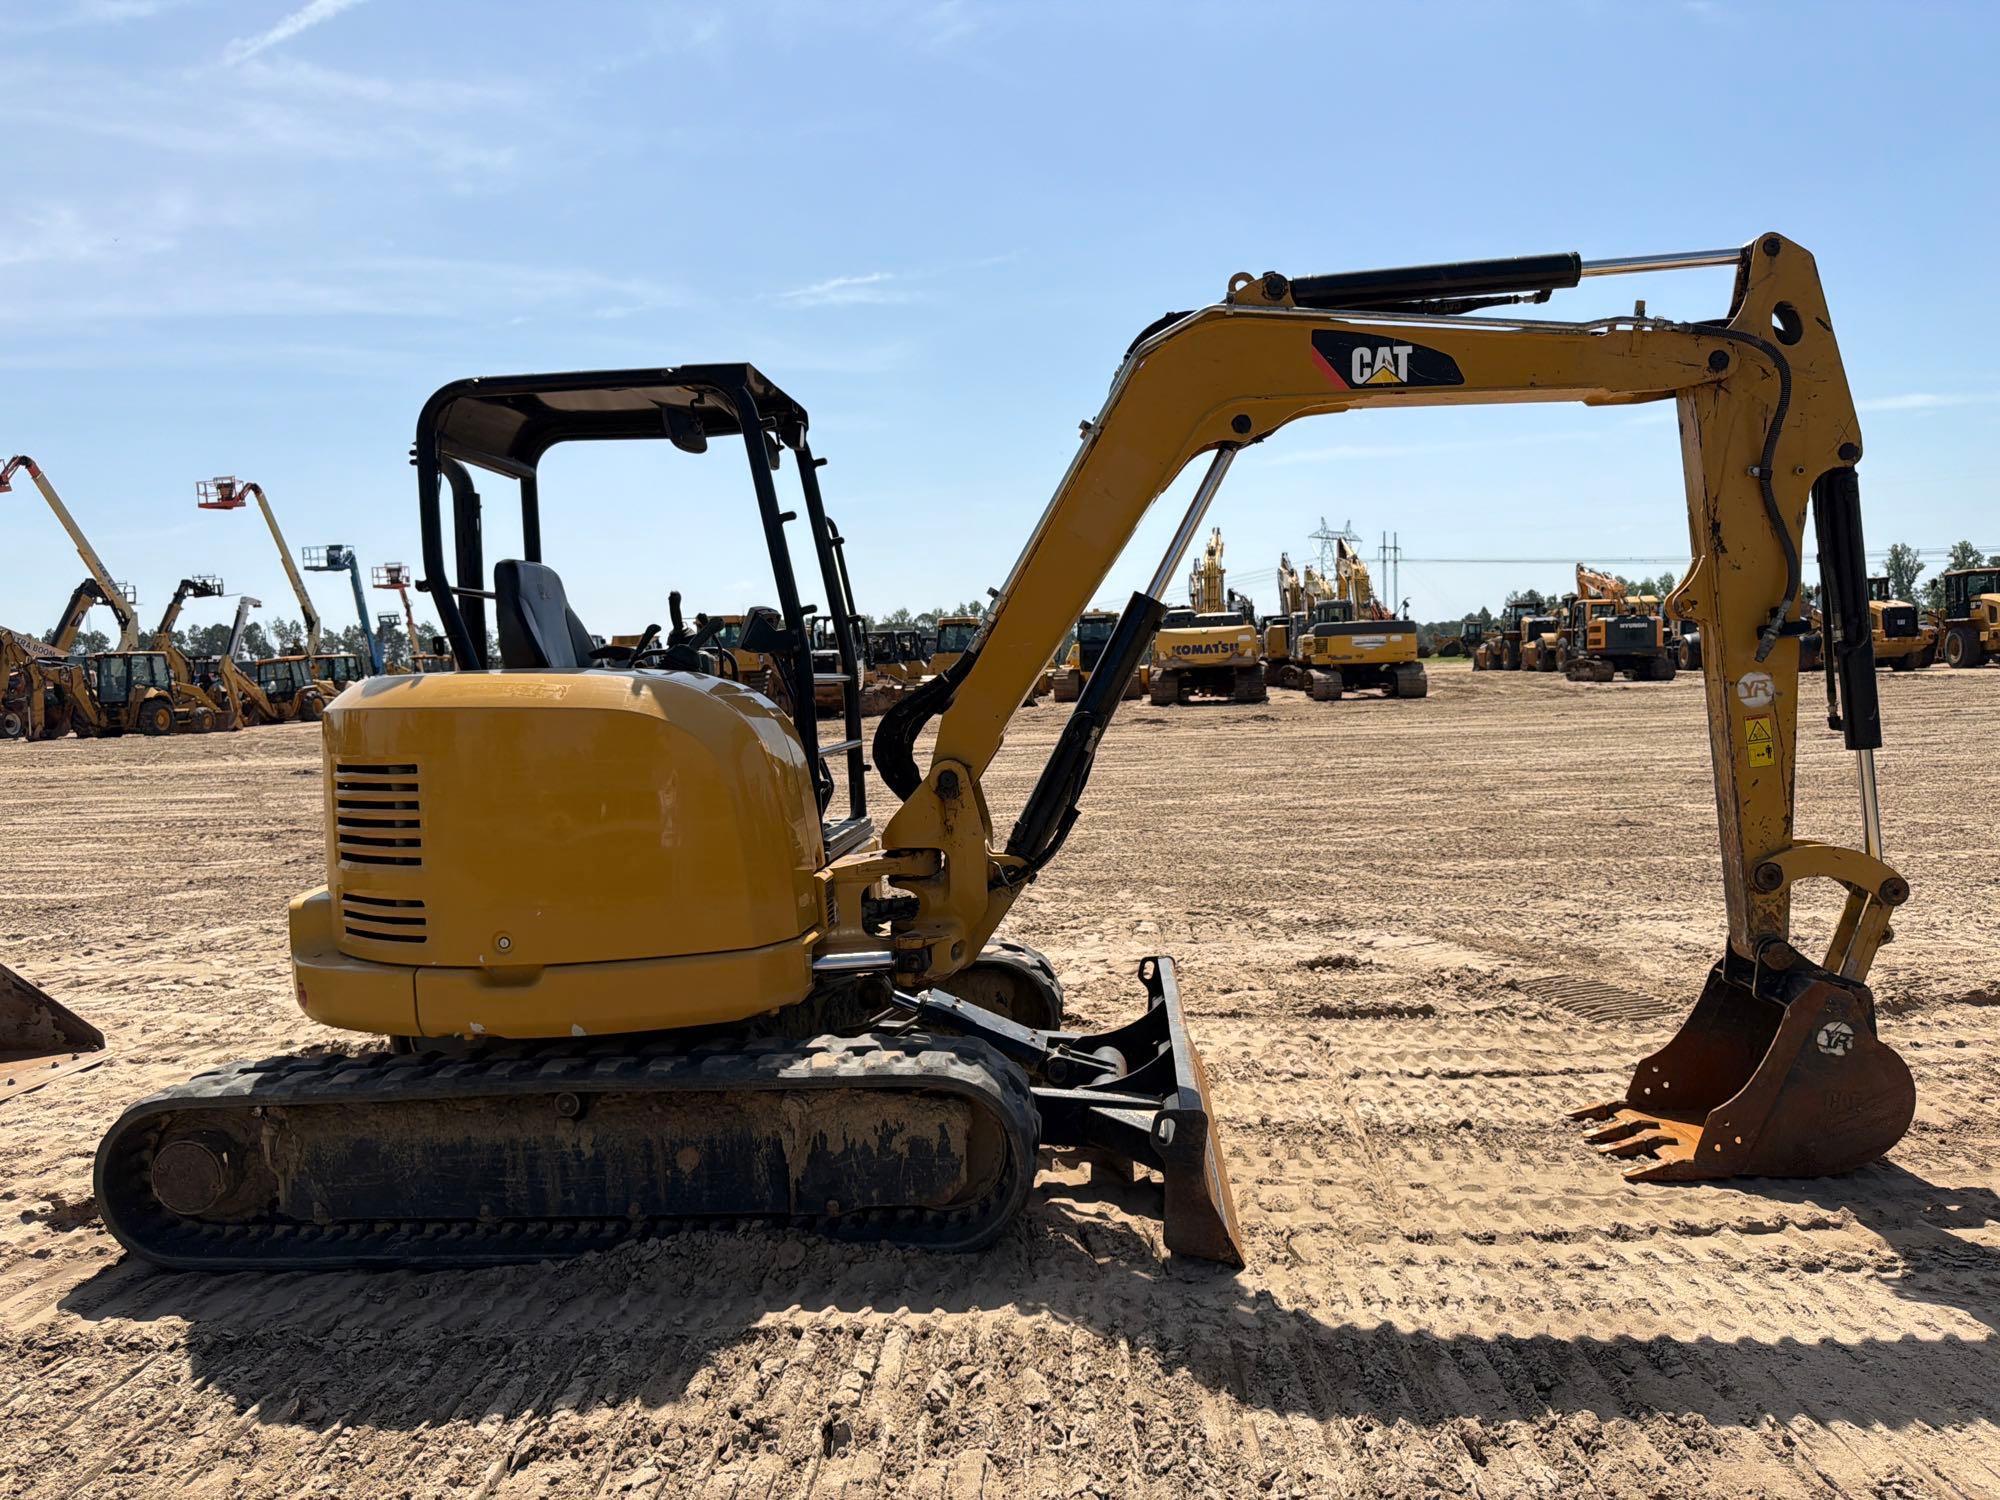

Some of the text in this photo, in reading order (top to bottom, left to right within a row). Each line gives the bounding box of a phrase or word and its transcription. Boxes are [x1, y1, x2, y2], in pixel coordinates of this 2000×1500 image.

[1352, 345, 1413, 385] CAT
[1172, 641, 1239, 656] KOMATSU
[1738, 680, 1770, 699] YR
